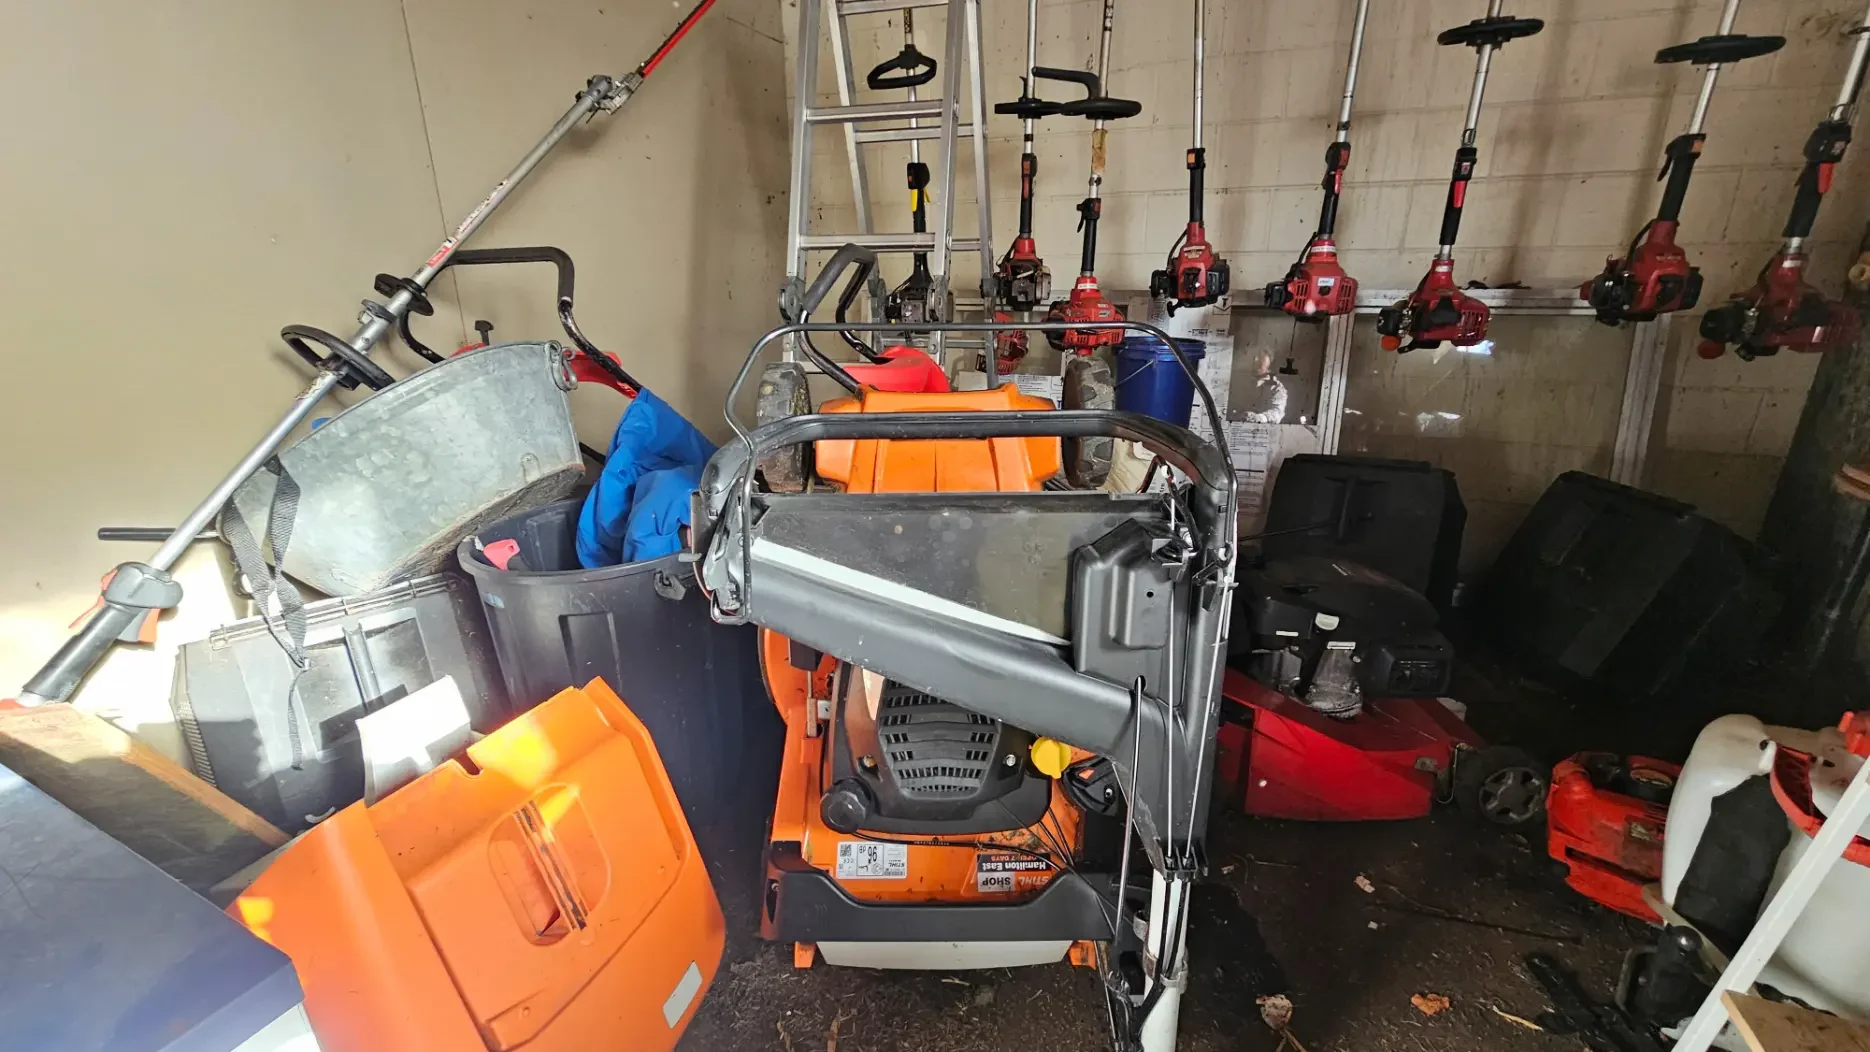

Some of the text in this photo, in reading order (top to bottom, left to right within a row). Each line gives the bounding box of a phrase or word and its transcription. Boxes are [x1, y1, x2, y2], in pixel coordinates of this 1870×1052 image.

[867, 846, 878, 862] 96
[982, 861, 1046, 871] Hamilton East
[982, 876, 1050, 886] STIHL SHOP
